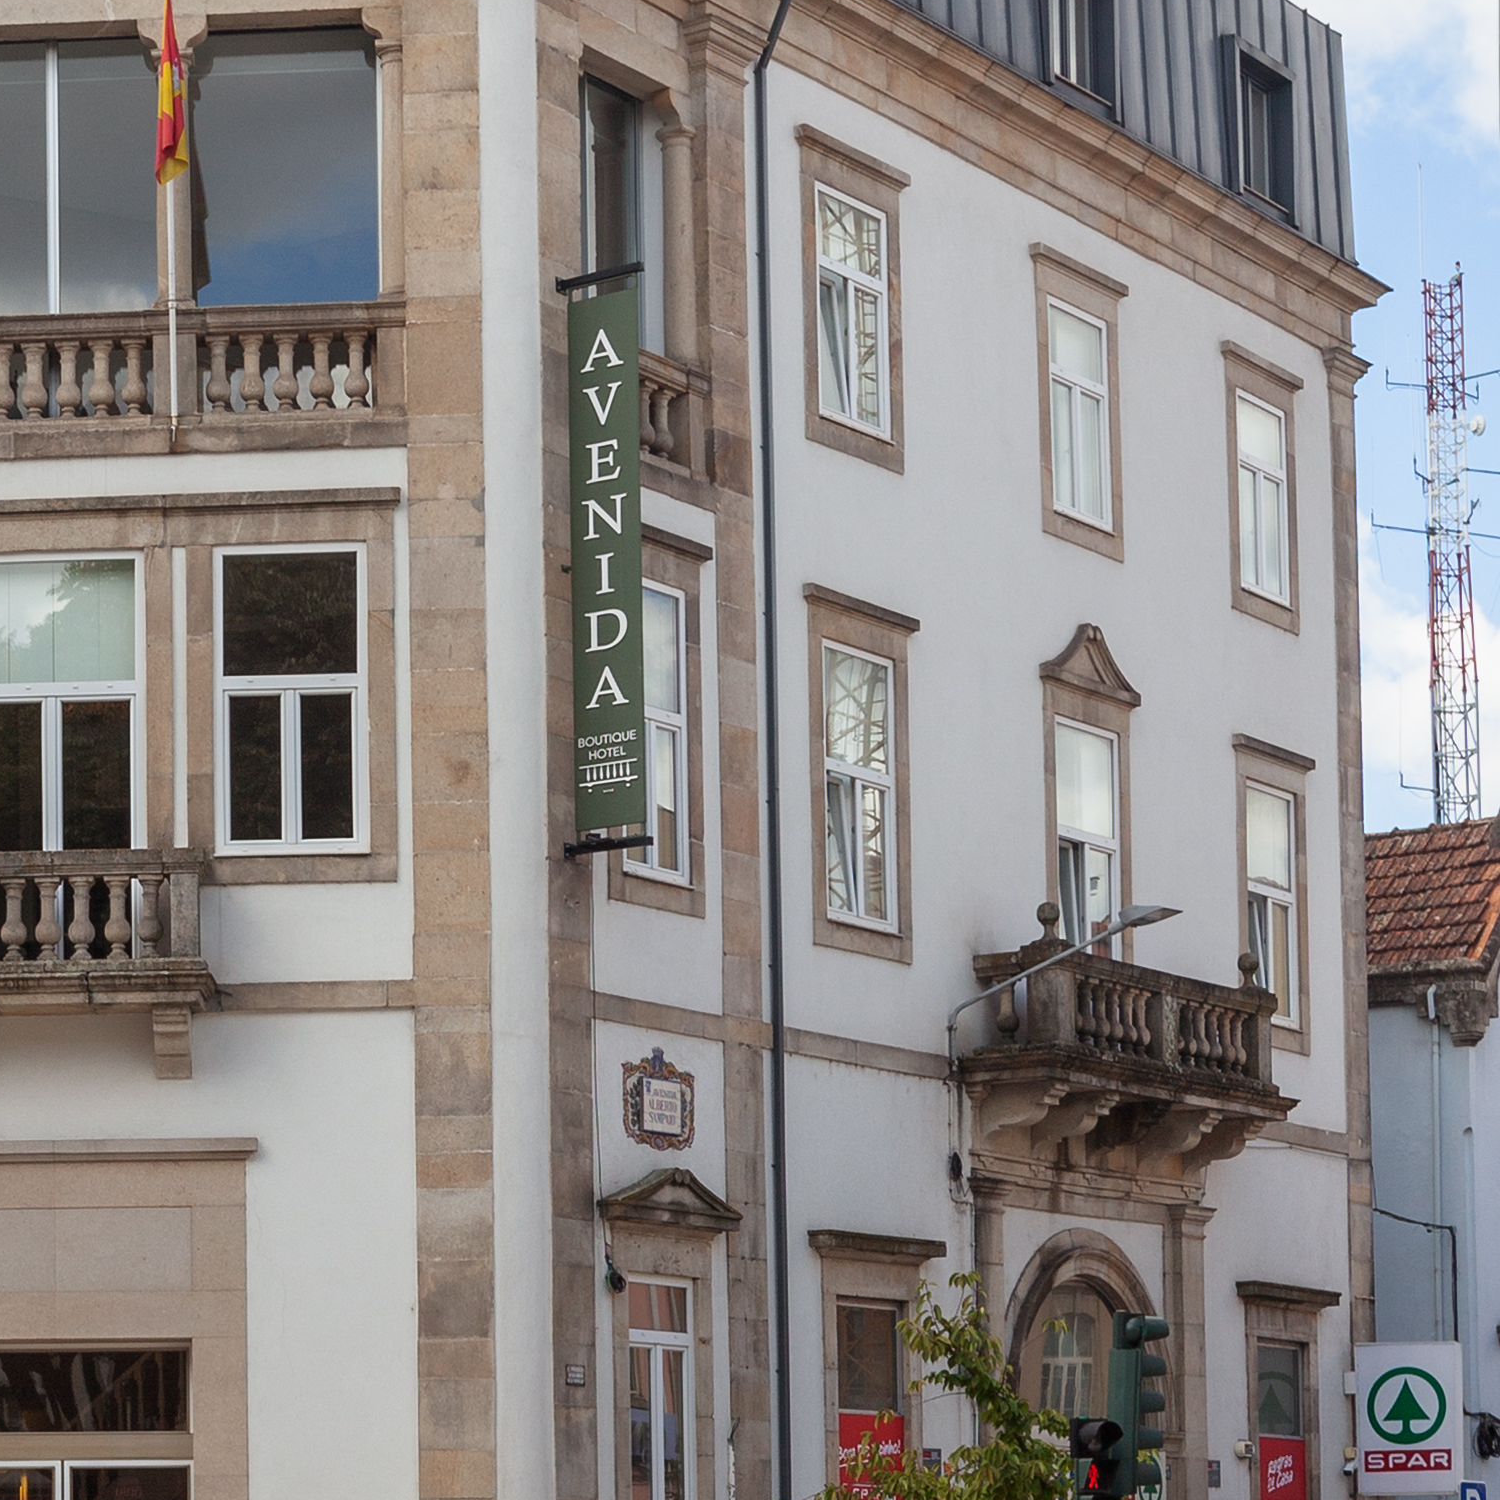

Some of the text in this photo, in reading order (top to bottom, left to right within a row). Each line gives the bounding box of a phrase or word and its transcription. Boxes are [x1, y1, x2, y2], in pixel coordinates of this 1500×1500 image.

[580, 328, 630, 710] AVENIDA
[577, 728, 637, 749] BOUTIQUE
[588, 745, 626, 760] HOTEL
[1367, 1452, 1449, 1469] SPAR
